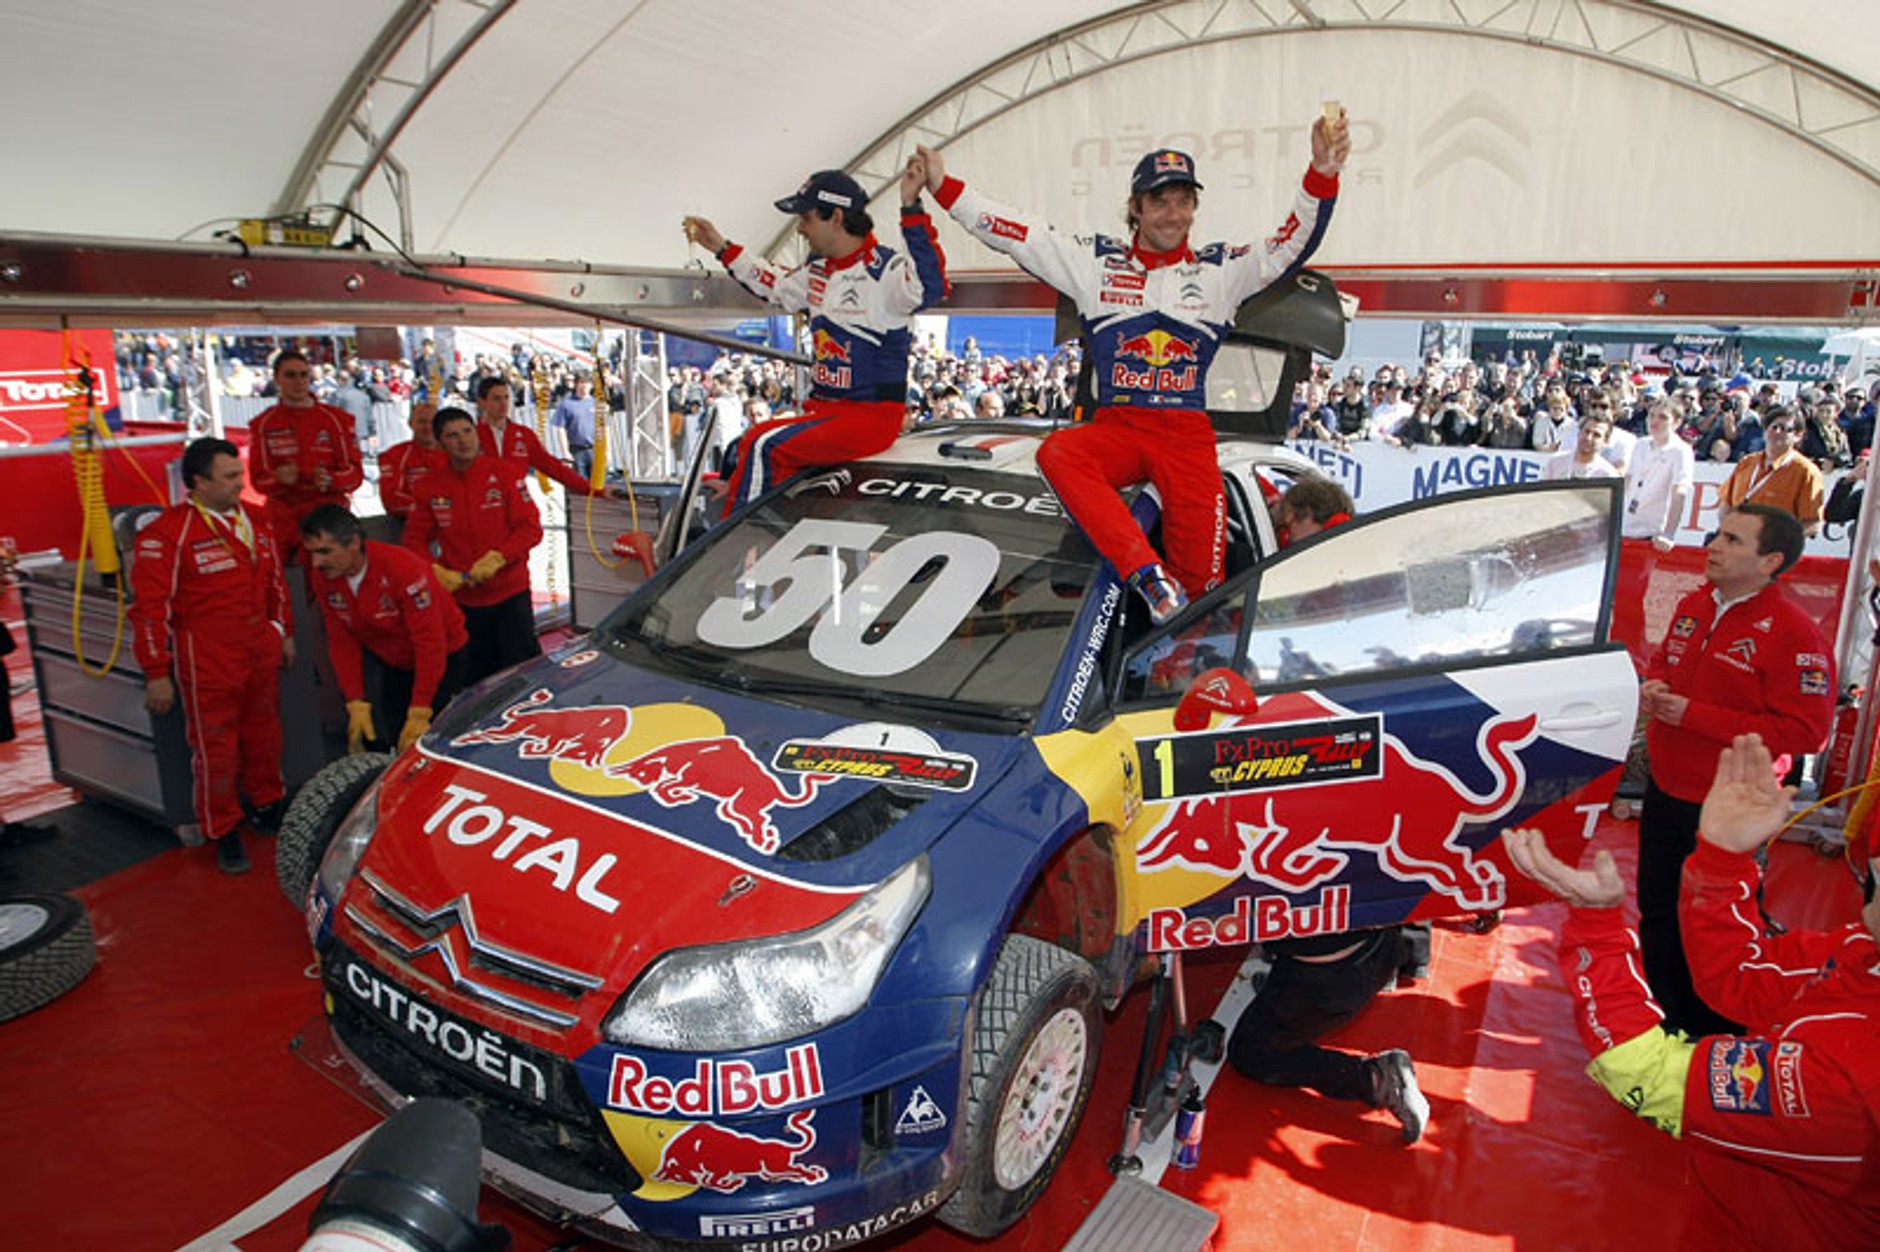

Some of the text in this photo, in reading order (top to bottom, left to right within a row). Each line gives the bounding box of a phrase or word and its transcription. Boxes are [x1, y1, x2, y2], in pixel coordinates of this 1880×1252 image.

[1506, 330, 1554, 340] Stobart
[1673, 335, 1724, 346] Stobart
[1112, 363, 1198, 391] Red Bull
[857, 478, 1068, 518] CITROË
[696, 519, 1000, 676] 50
[880, 732, 889, 746] 1
[1214, 736, 1289, 763] FxPro
[815, 759, 893, 777] CYPRUS
[1154, 740, 1174, 798] 1
[1233, 754, 1309, 782] CYPRUS
[422, 784, 621, 913] TOTAL
[1147, 885, 1350, 952] Red Bull
[346, 962, 545, 1099] CITROËN
[607, 1044, 826, 1116] Red Bull
[1779, 1056, 1801, 1114] TOTAL
[700, 1206, 815, 1237] PIRELLI
